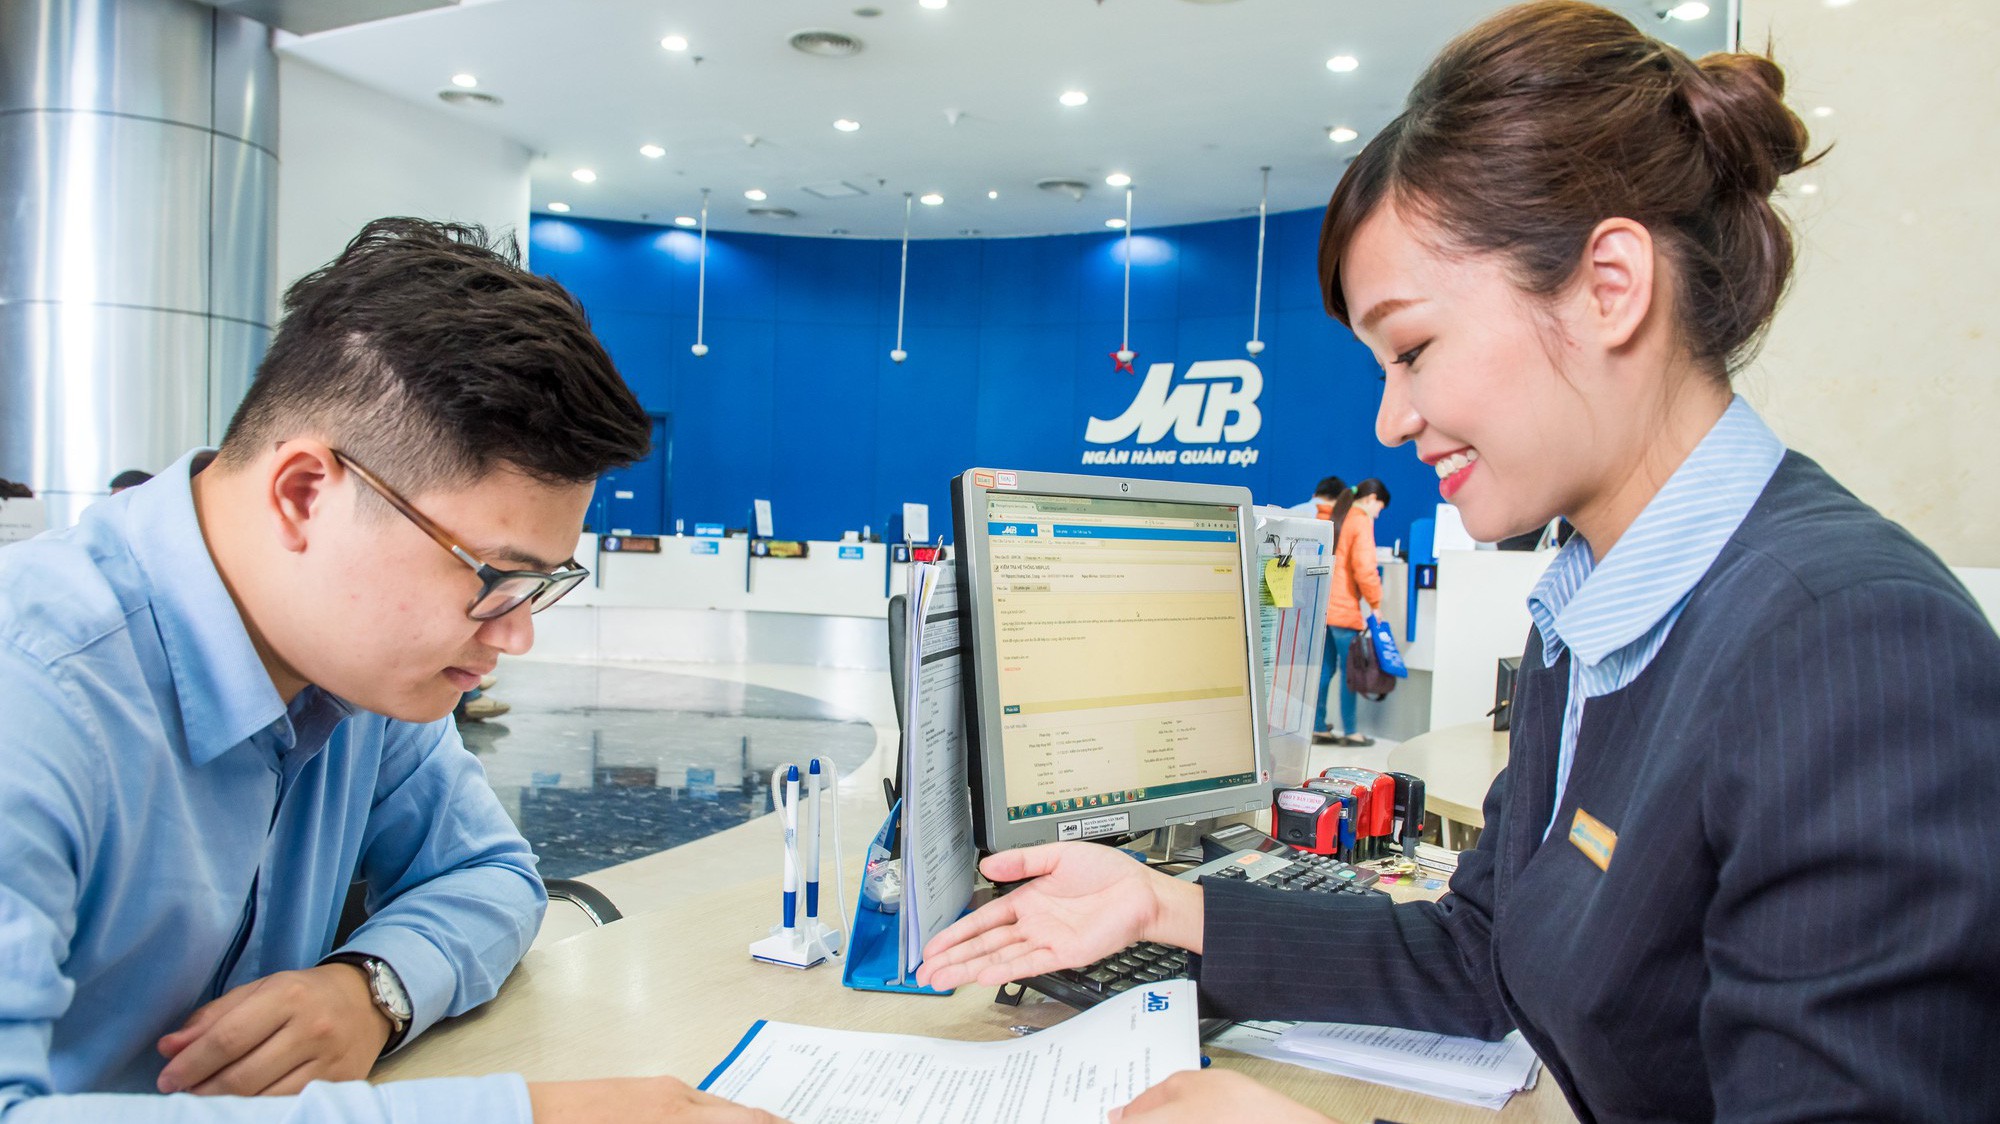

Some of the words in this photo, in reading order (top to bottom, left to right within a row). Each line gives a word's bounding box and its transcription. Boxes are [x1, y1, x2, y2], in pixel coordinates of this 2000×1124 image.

[1084, 359, 1264, 444] MB
[1082, 448, 1129, 465] NGÂN
[1130, 447, 1177, 465] HÀNG
[1179, 447, 1226, 465] QUÂN
[1227, 446, 1259, 468] ĐỘI
[1422, 568, 1430, 585] 1
